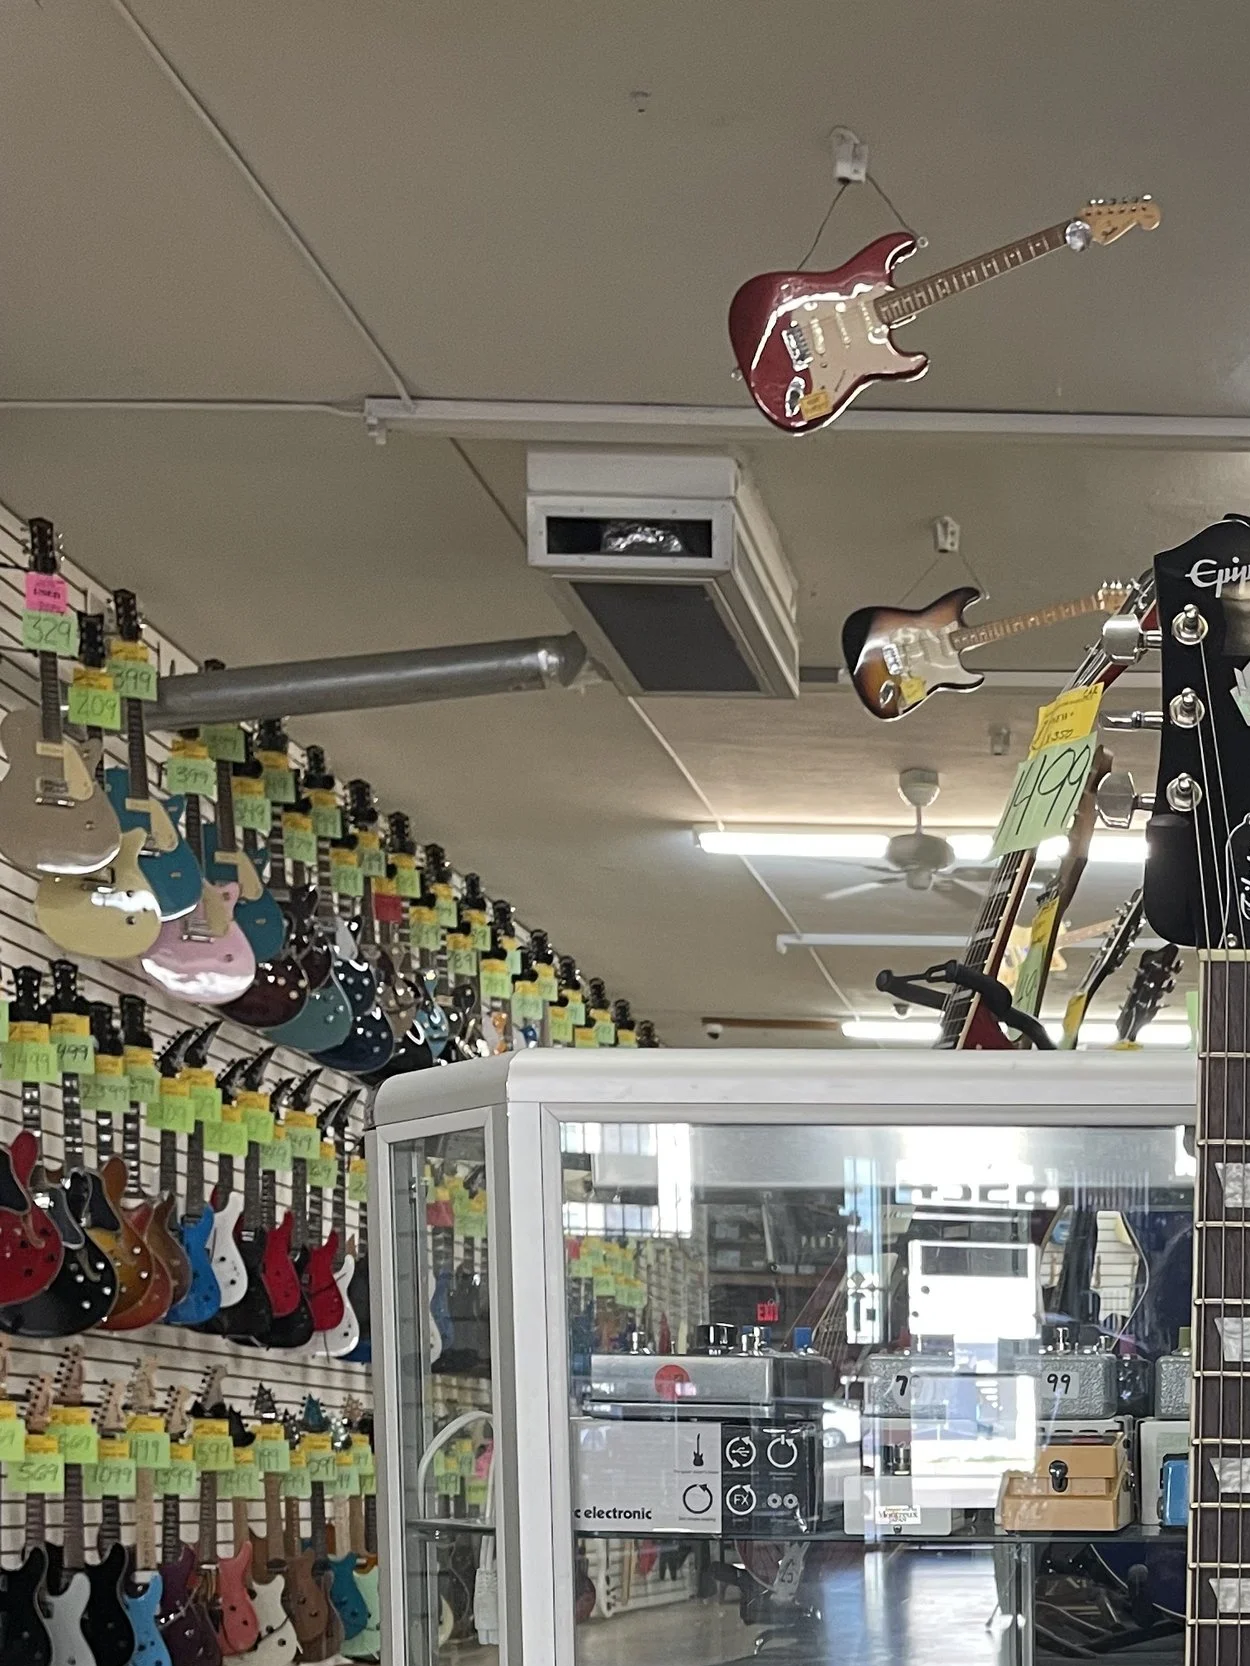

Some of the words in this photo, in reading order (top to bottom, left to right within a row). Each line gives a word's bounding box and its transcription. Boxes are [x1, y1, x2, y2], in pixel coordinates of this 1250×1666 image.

[27, 615, 71, 647] 329
[75, 692, 117, 718] 209
[1046, 1373, 1071, 1395] 99
[733, 1494, 749, 1506] FX
[585, 1506, 653, 1520] electronic
